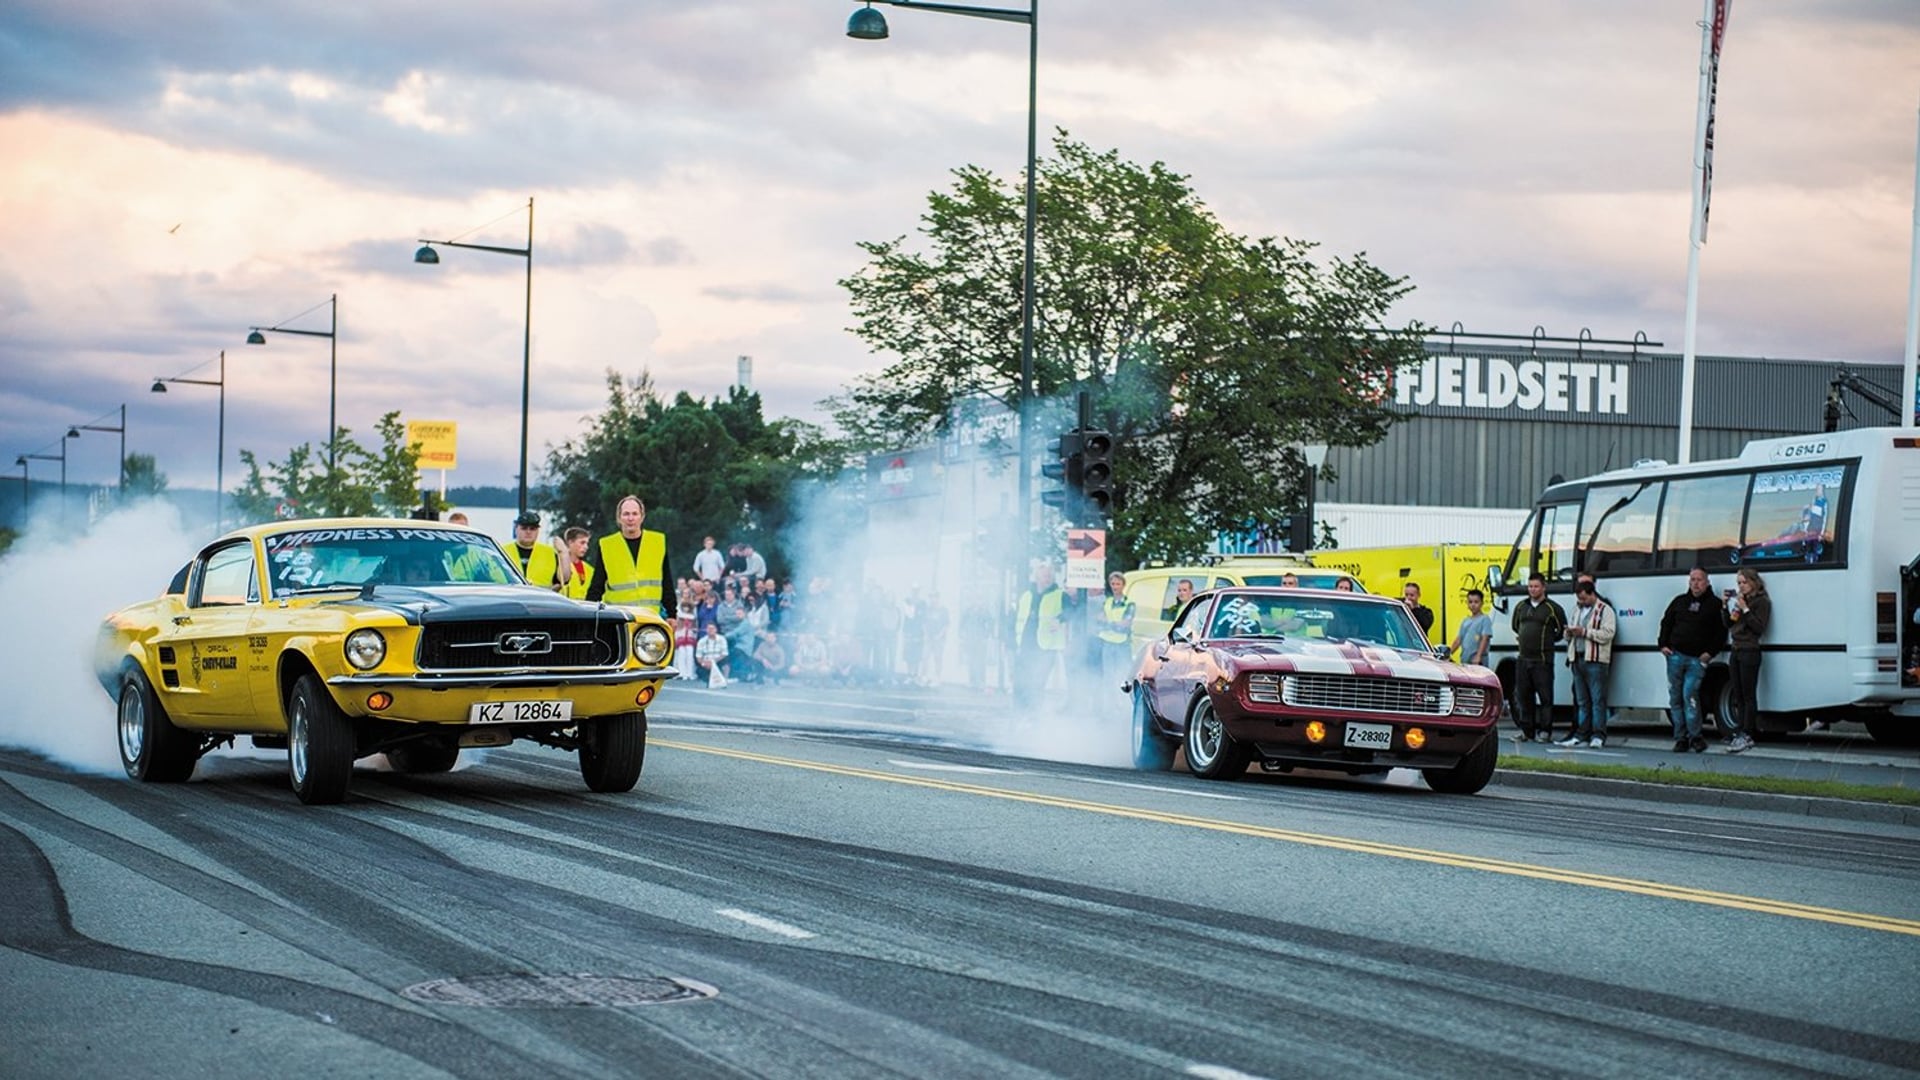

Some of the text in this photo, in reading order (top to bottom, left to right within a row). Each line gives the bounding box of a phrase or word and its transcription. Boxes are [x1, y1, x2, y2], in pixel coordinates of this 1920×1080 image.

[1395, 355, 1629, 414] FJELDSETH
[275, 530, 395, 549] MADNESS
[397, 529, 483, 545] POWER
[479, 702, 562, 721] KZ 12864
